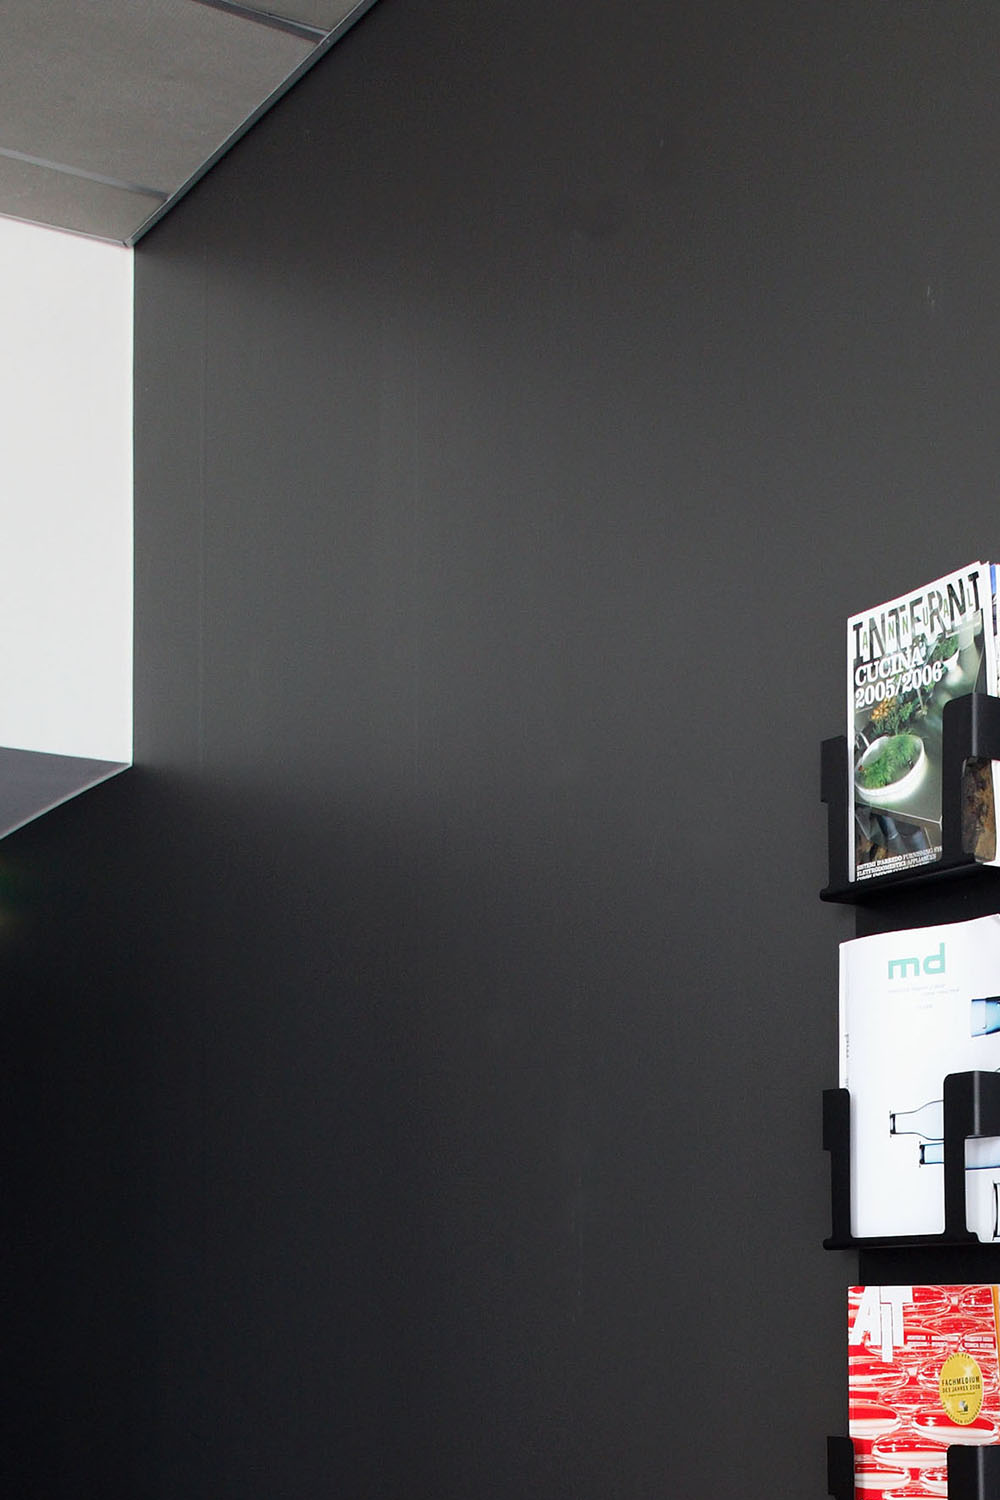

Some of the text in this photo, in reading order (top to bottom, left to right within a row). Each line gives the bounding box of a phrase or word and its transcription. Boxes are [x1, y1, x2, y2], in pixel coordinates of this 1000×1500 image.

[852, 571, 980, 663] INTERNI
[855, 649, 925, 687] CUCINA
[855, 662, 943, 709] 2005/2006
[888, 942, 945, 980] md
